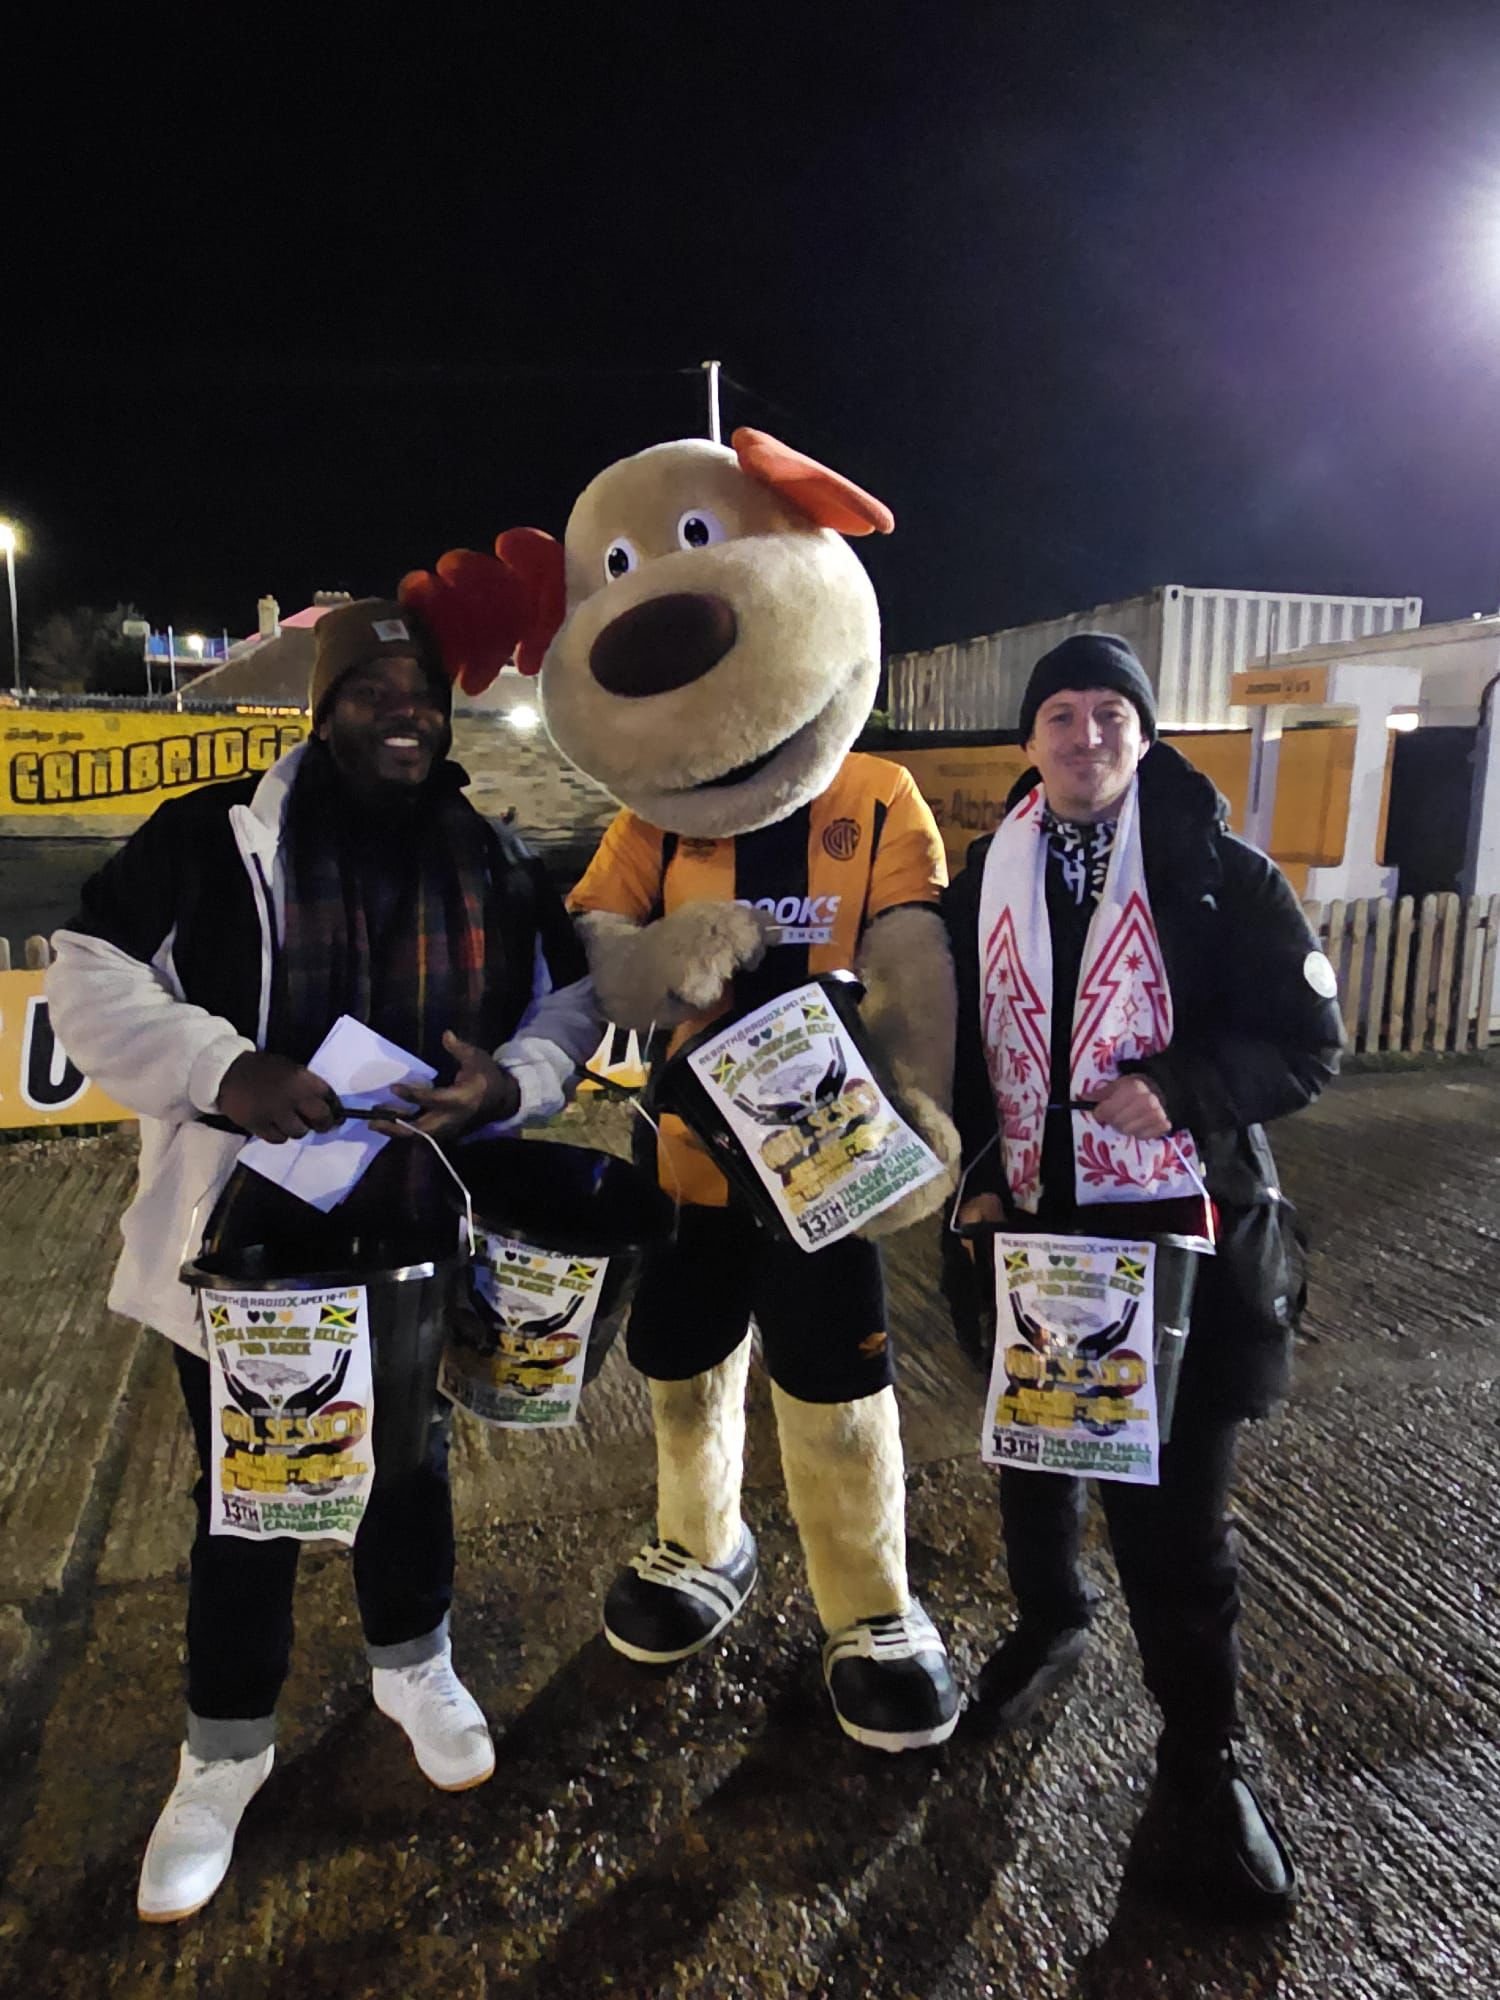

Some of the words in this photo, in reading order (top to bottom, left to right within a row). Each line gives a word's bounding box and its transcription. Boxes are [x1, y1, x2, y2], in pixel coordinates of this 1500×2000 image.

[698, 1034, 740, 1065] REBIRTH
[799, 1202, 842, 1237] 13TH
[250, 1297, 286, 1308] RADIO
[992, 1434, 1040, 1456] 13TH
[222, 1498, 259, 1522] 13TH
